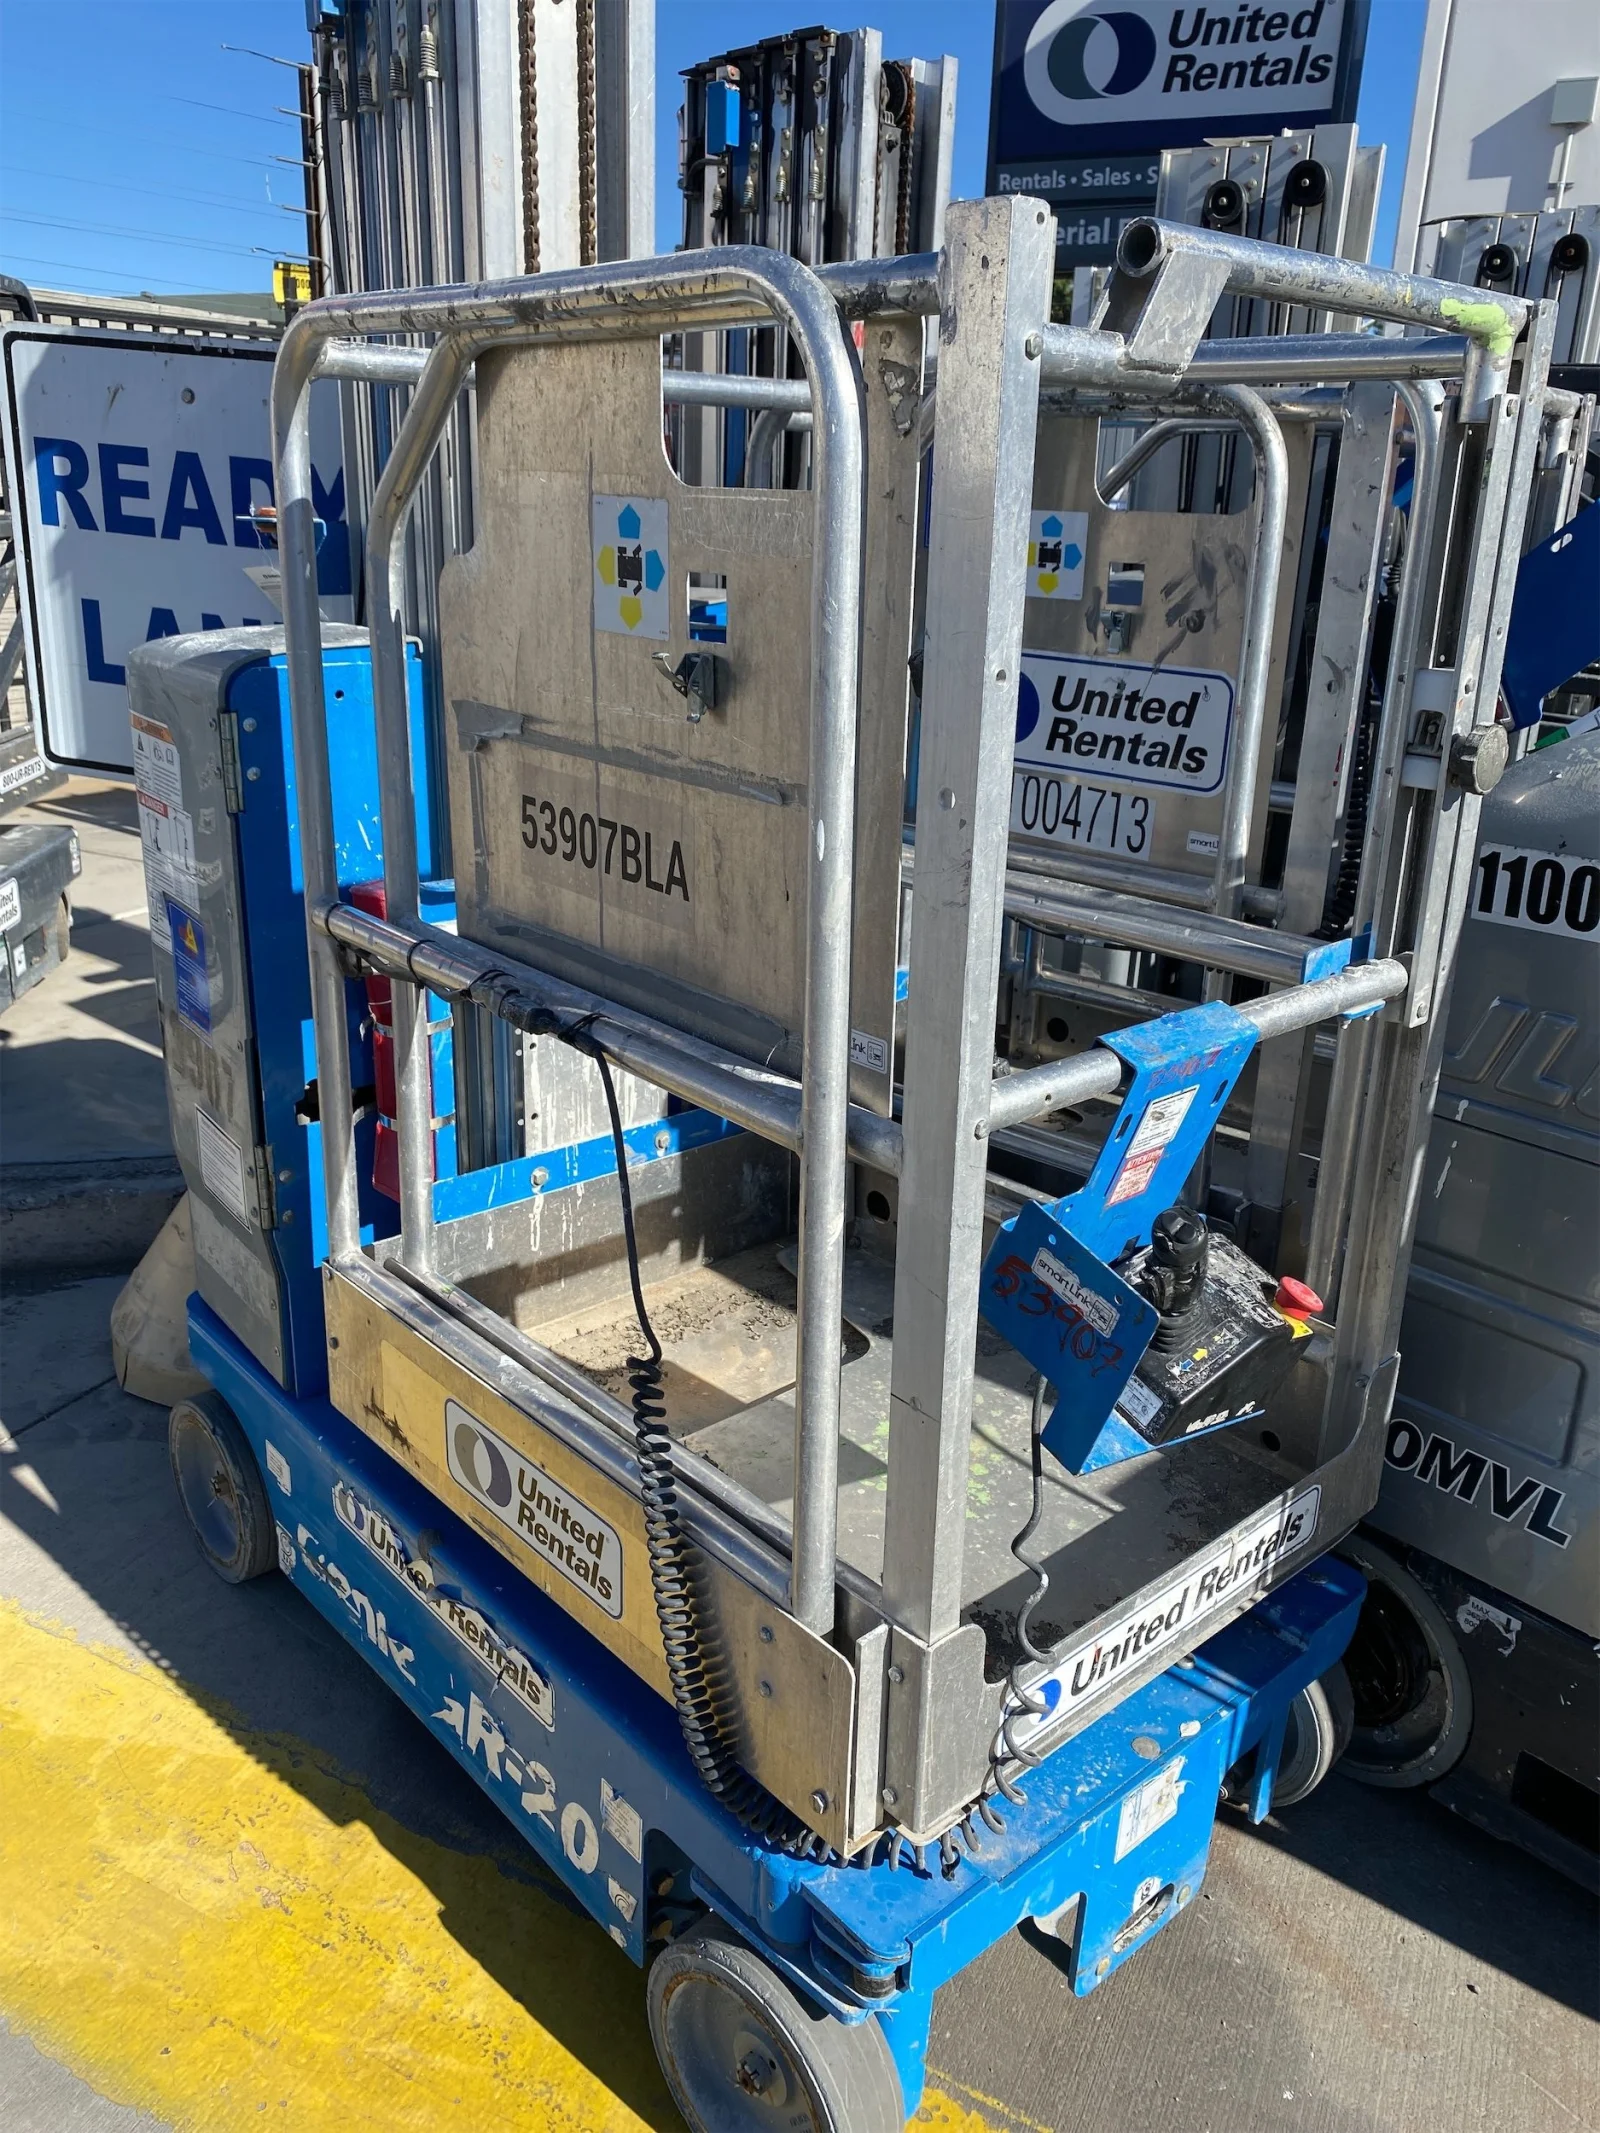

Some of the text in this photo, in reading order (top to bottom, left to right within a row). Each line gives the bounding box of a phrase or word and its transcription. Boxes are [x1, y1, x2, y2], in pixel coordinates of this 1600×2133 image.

[1168, 1, 1325, 48] United
[1161, 44, 1333, 94] Rentals
[999, 169, 1066, 193] Rentals
[1081, 166, 1131, 188] Sales
[1055, 216, 1111, 246] erial
[1051, 676, 1201, 729] United
[1045, 717, 1208, 774] Rentals
[521, 794, 690, 902] 53907BLA
[517, 1467, 605, 1561] United
[517, 1500, 613, 1600] Rentals
[1070, 1511, 1305, 1697] United Rentals
[1471, 1602, 1491, 1618] MAX
